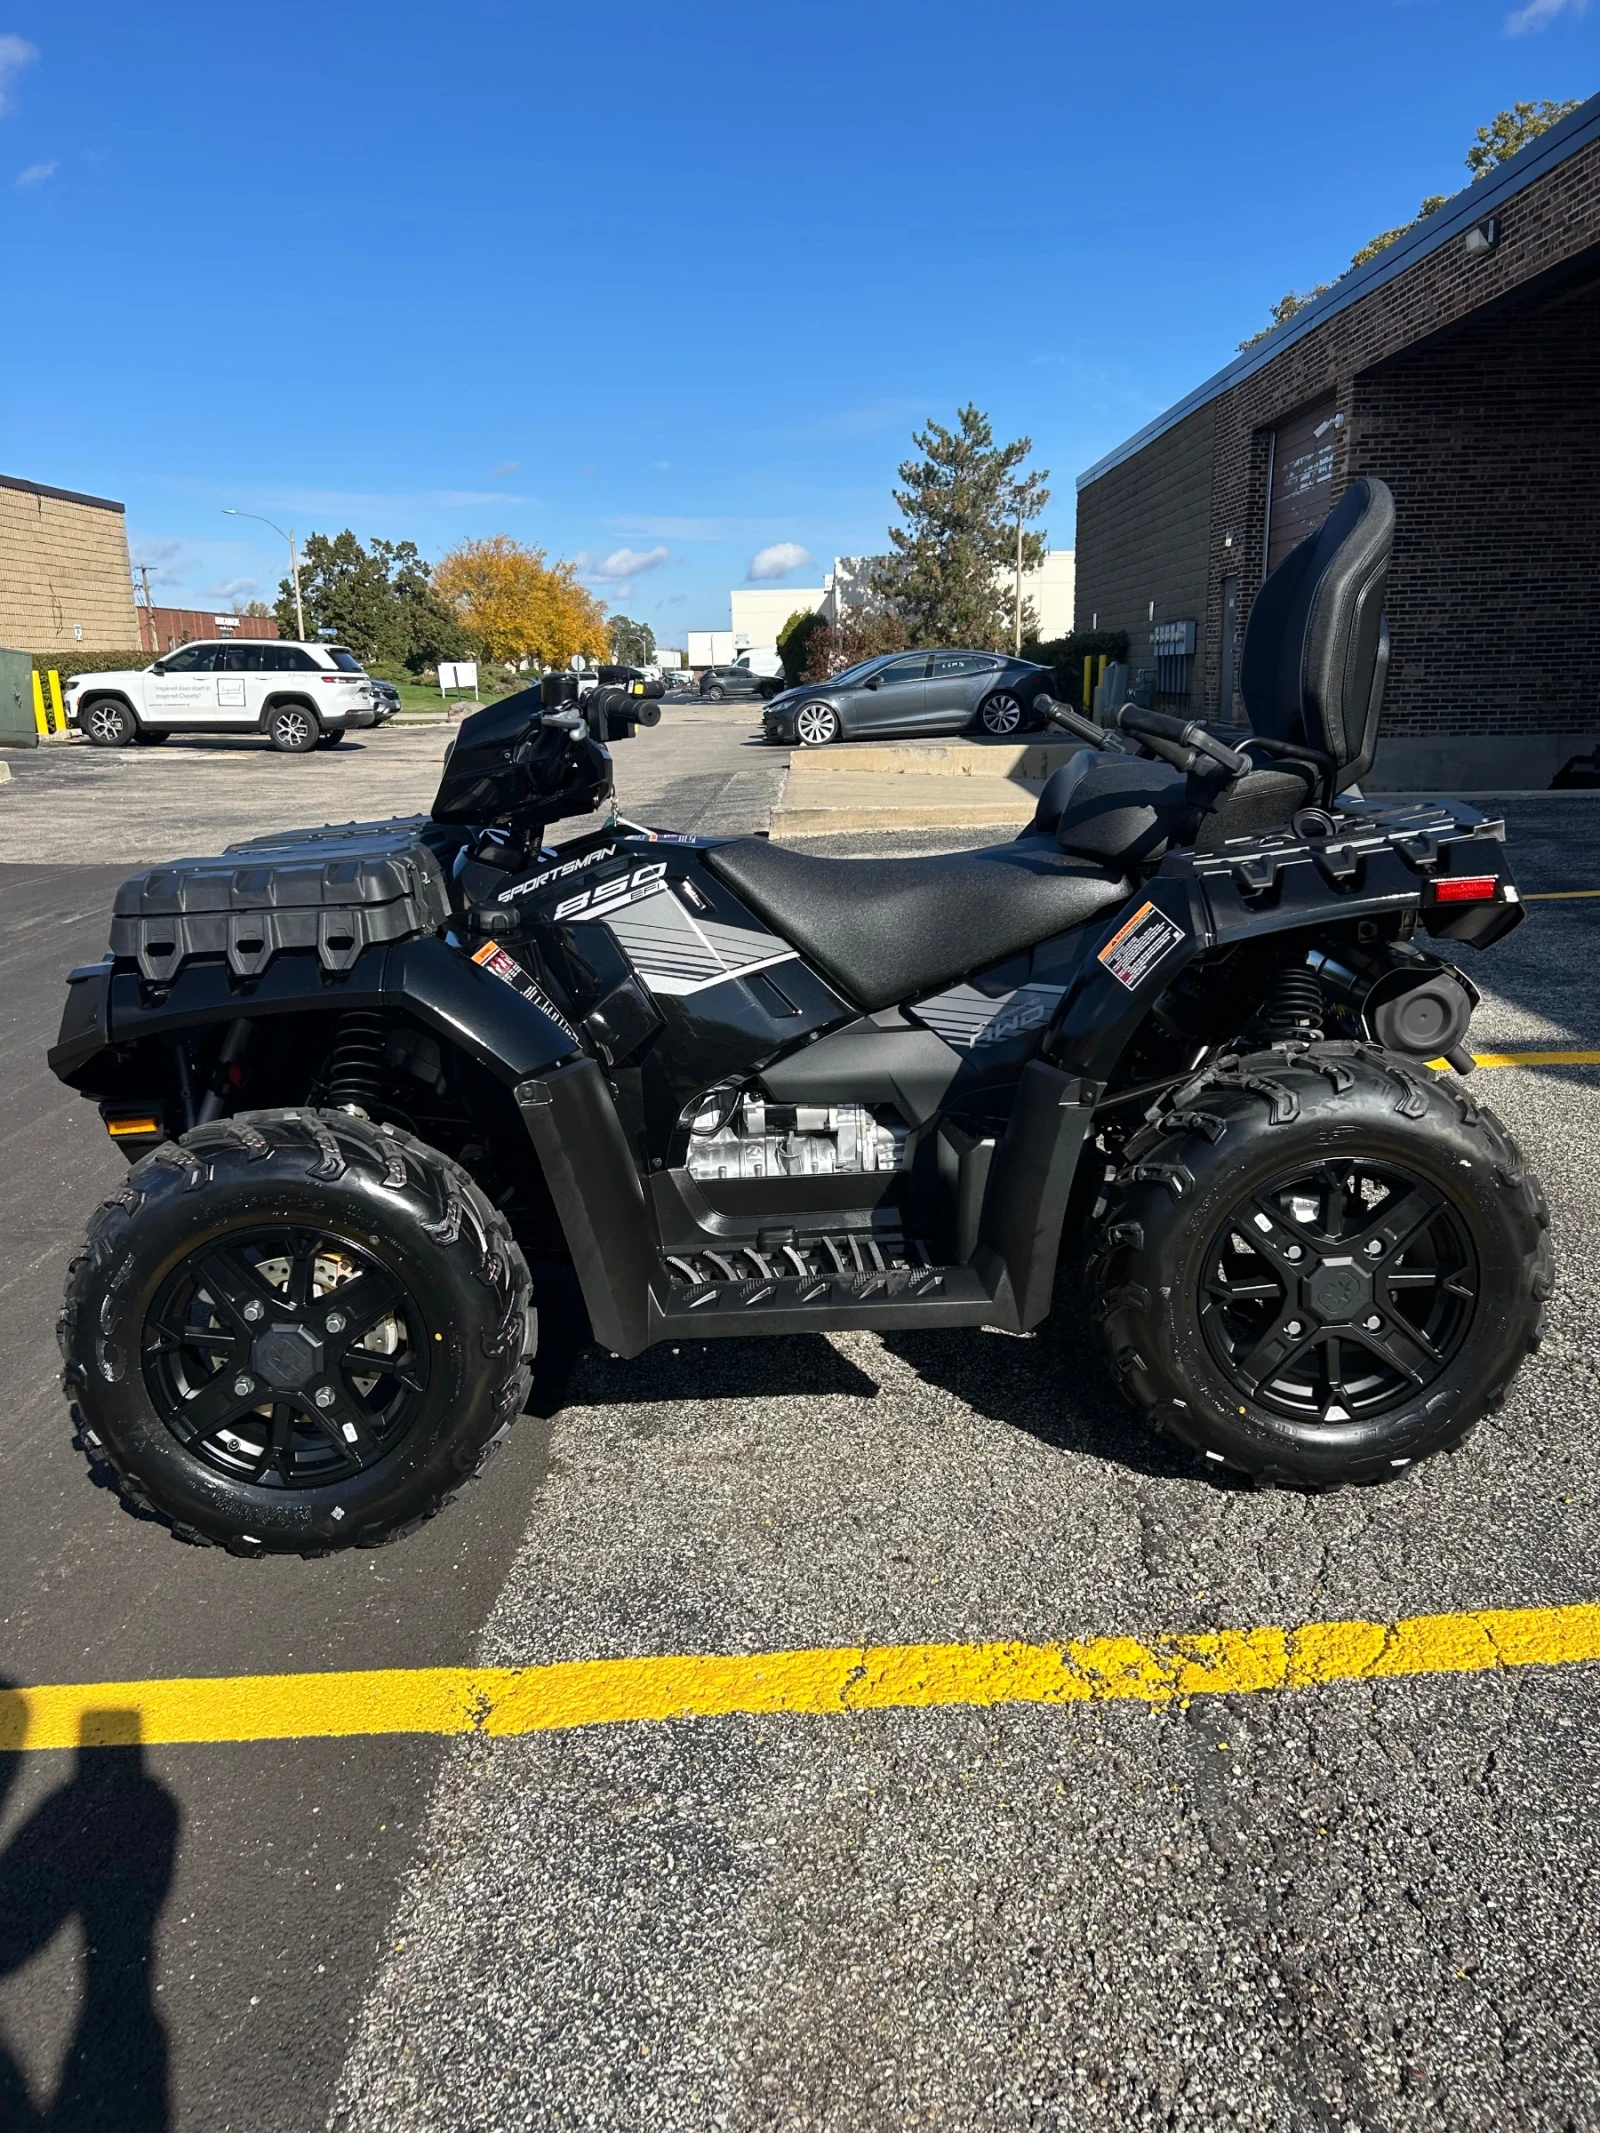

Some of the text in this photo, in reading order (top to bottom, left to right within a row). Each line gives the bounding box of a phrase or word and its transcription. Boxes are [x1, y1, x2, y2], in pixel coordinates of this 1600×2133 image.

[497, 844, 617, 903] SPORTSMAN
[552, 862, 668, 921] 850
[629, 881, 661, 901] EFI
[1114, 915, 1140, 941] WARNING
[969, 1005, 1045, 1049] AWD
